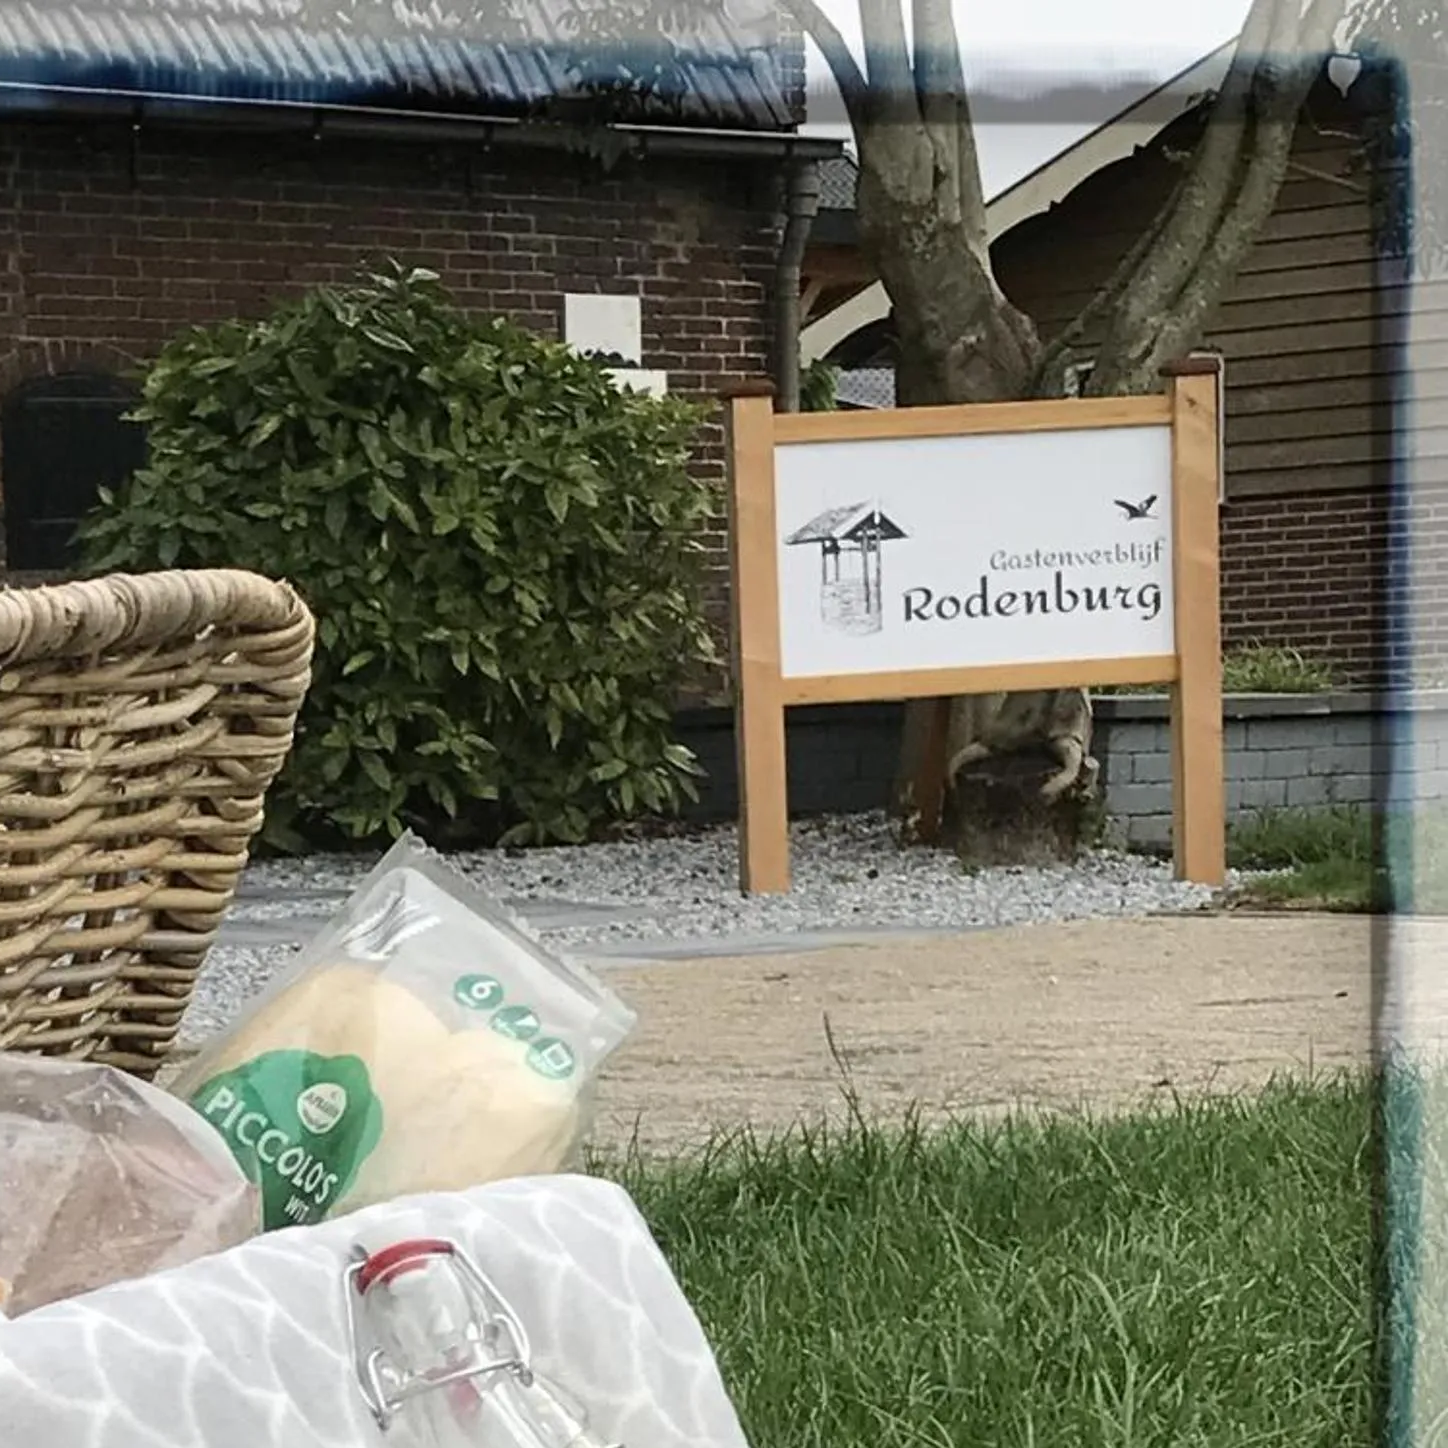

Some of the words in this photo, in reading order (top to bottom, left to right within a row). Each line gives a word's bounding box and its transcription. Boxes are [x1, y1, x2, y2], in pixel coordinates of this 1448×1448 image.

[989, 536, 1165, 571] Gastenverblijf
[903, 570, 1162, 623] Rodenburg
[204, 1085, 339, 1205] PICCOLOS
